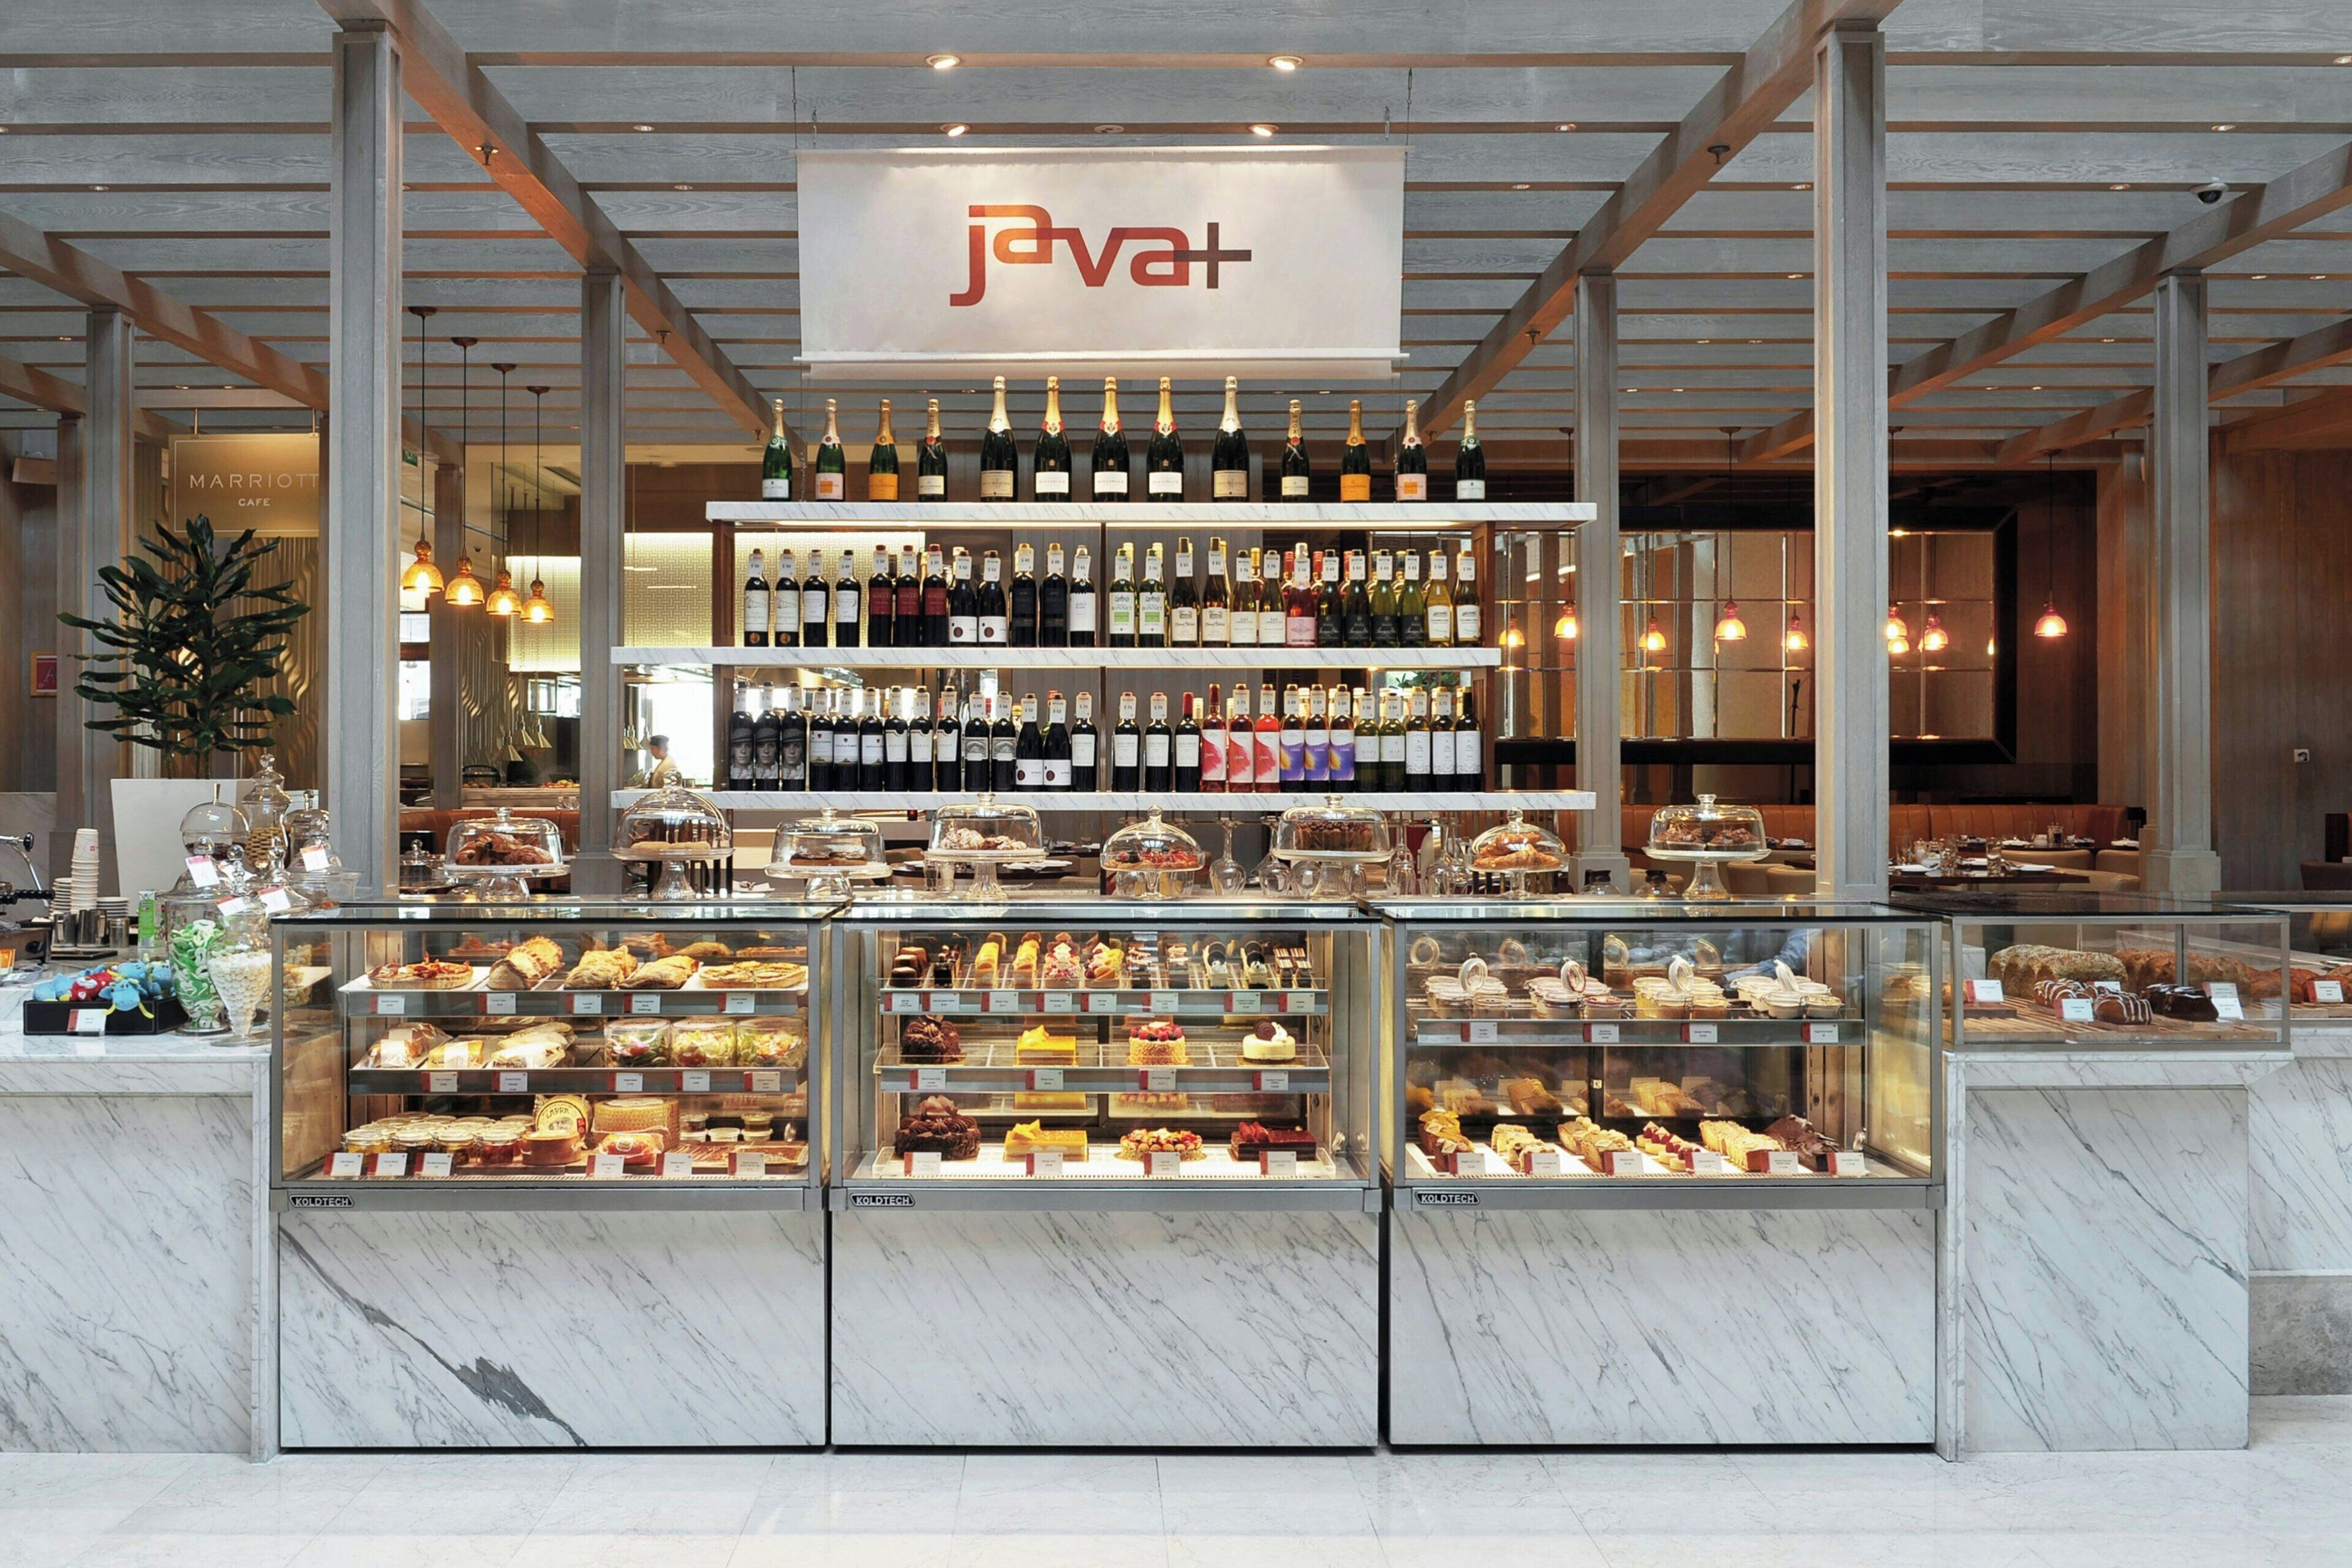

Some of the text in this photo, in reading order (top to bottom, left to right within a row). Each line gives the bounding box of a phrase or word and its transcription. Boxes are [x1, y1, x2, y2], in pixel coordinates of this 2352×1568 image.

[190, 473, 319, 488] MARRIOTT
[238, 498, 271, 507] CAFE
[296, 1198, 349, 1207] KOLDTECH
[856, 1197, 910, 1205] KOLDTECH
[1422, 1195, 1474, 1204] KOLDTECH
